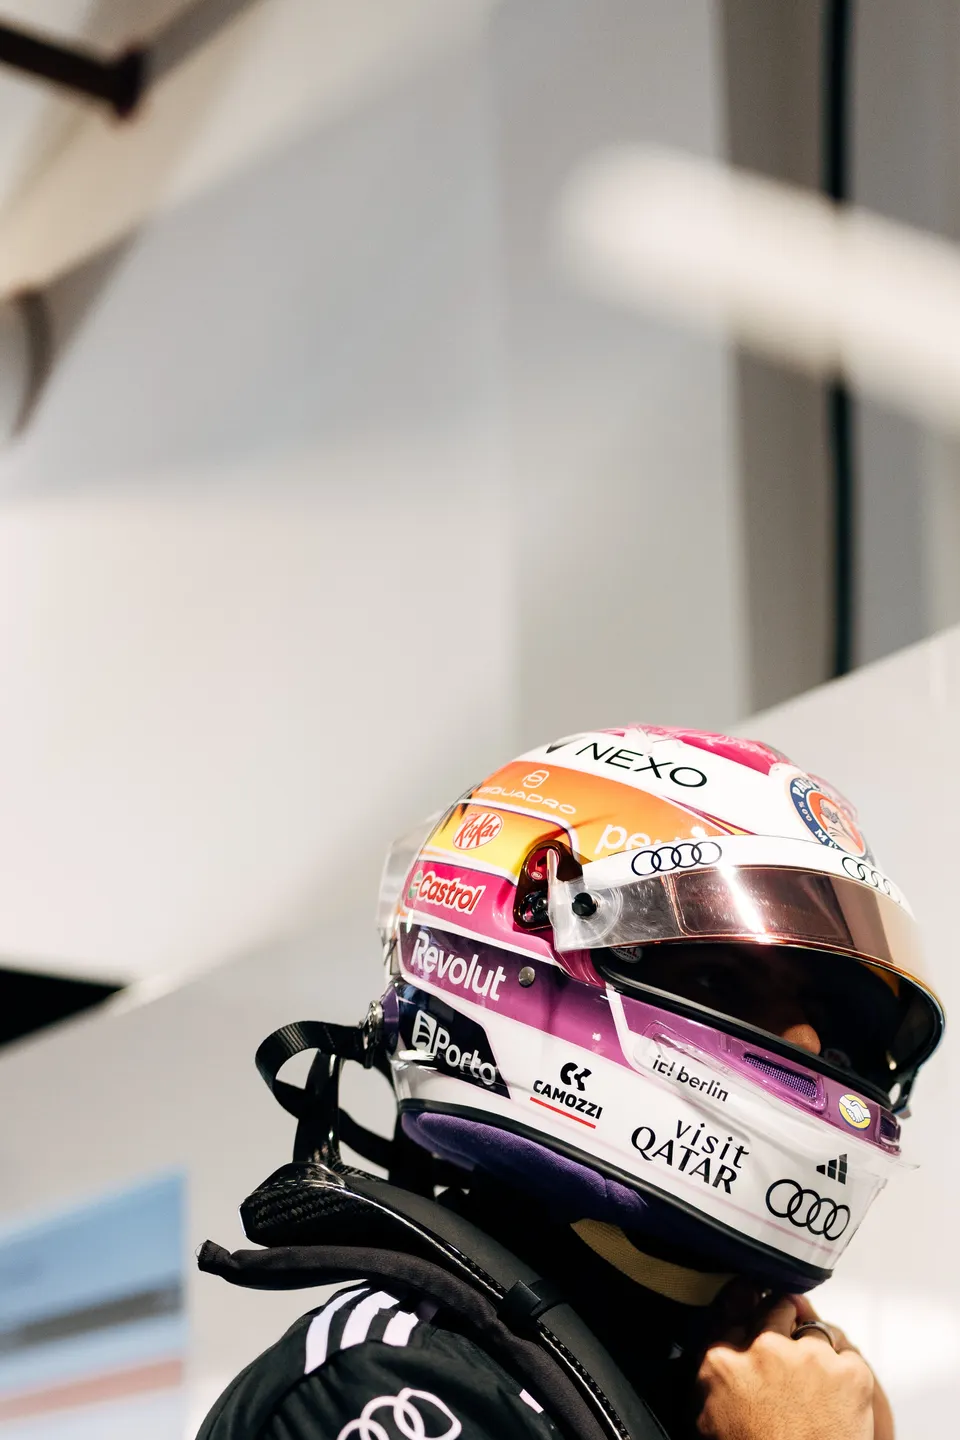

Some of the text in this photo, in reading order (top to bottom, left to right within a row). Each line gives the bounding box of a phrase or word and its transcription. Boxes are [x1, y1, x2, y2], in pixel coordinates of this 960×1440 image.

[575, 742, 708, 788] NEXO
[454, 814, 500, 848] KitKat
[418, 874, 482, 912] Castrol
[410, 931, 507, 1001] Revolut
[433, 1026, 496, 1086] Porto
[532, 1079, 603, 1119] CAMOZZI
[676, 1066, 729, 1102] berlin
[630, 1126, 737, 1194] QATAR
[675, 1119, 750, 1169] visit
